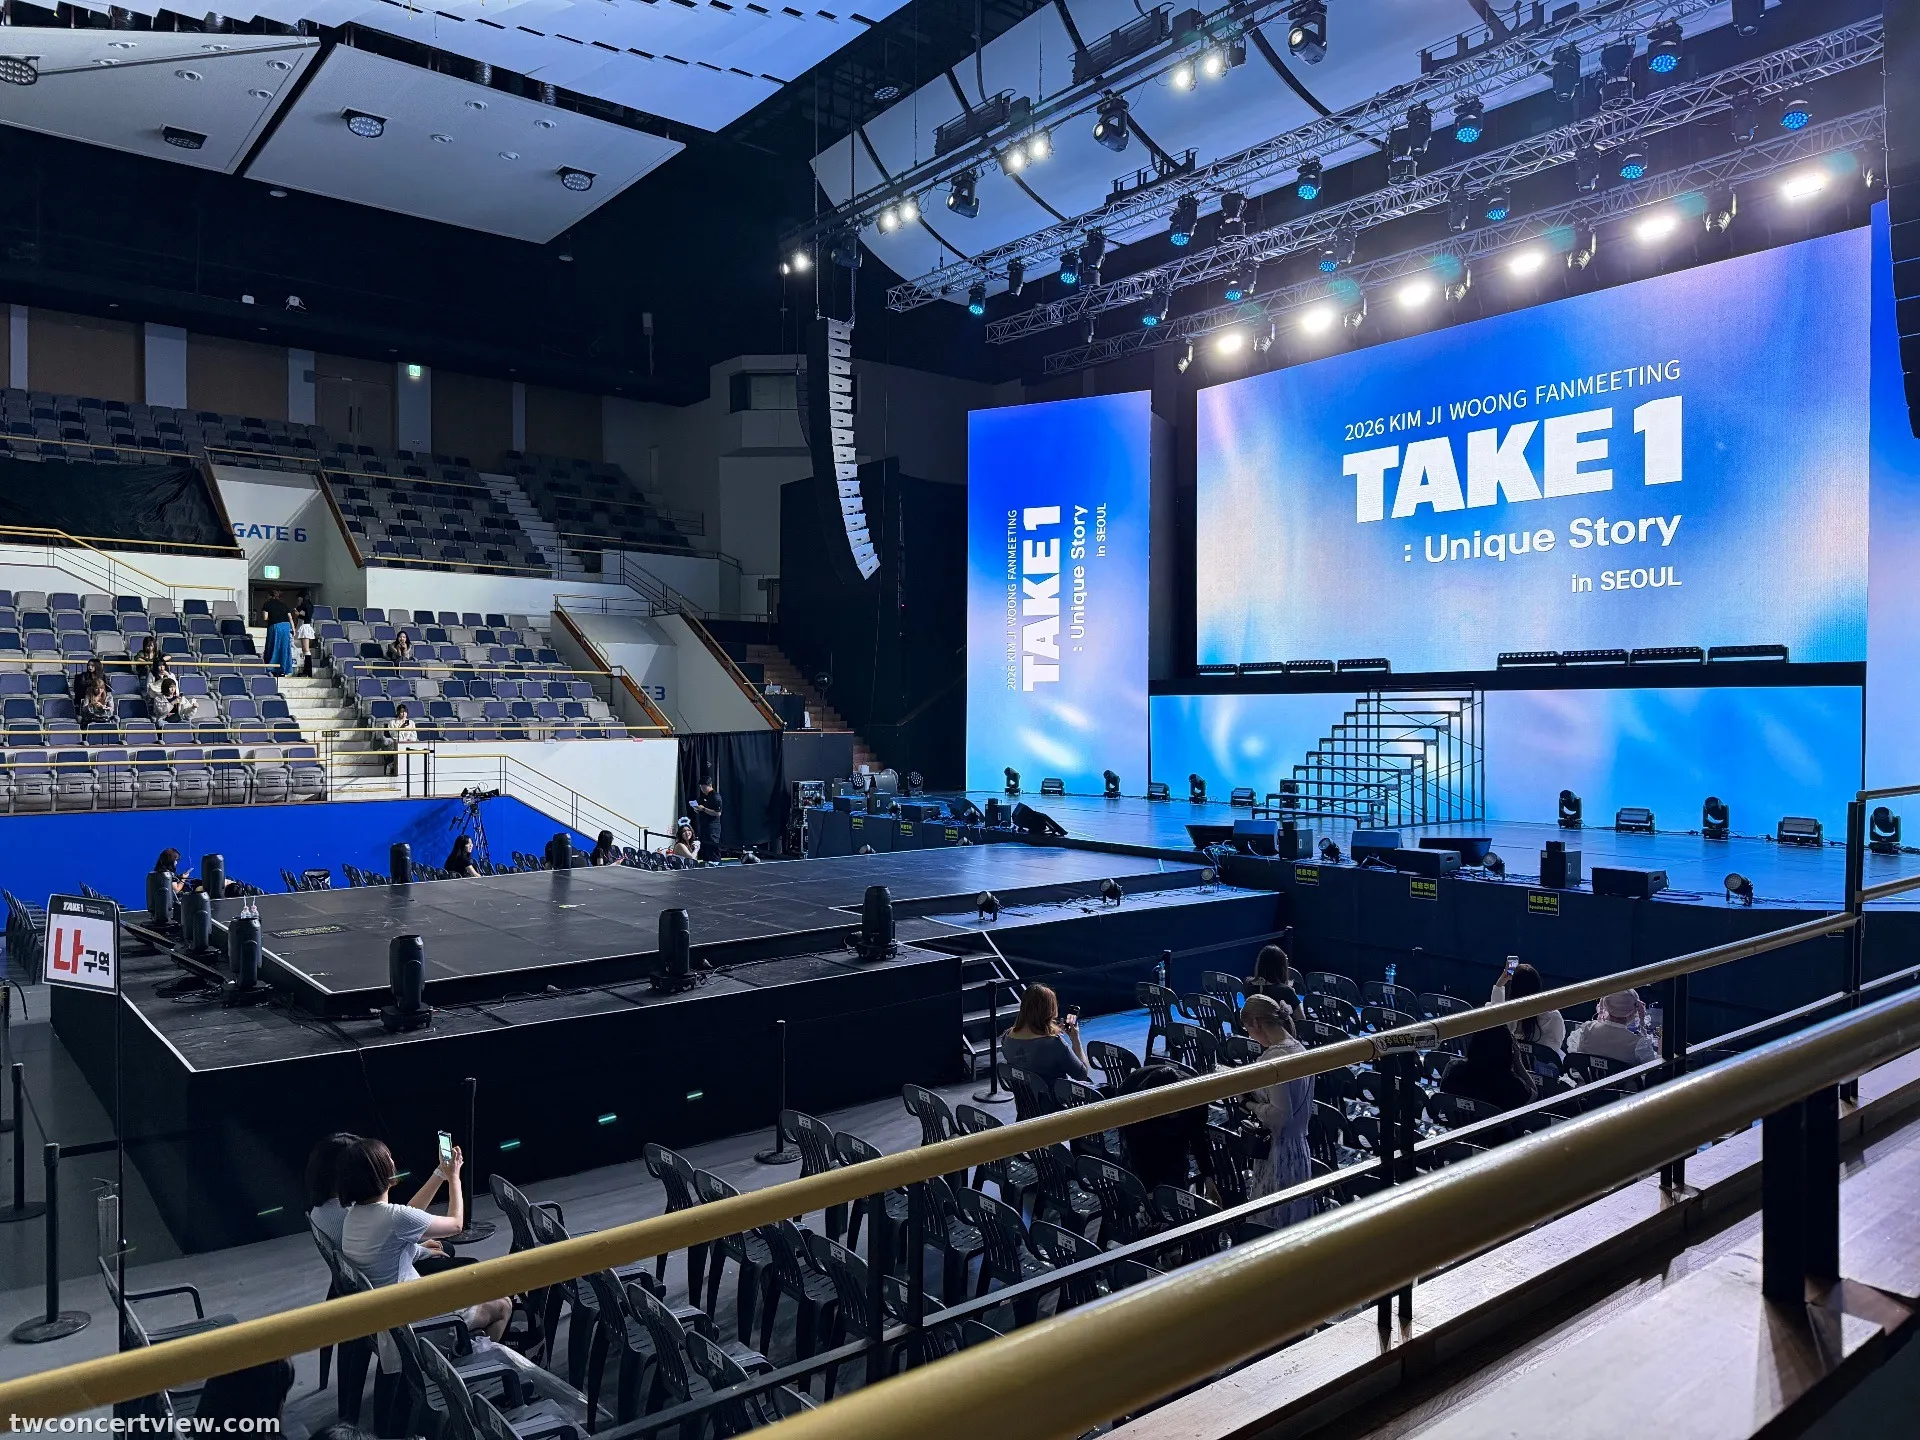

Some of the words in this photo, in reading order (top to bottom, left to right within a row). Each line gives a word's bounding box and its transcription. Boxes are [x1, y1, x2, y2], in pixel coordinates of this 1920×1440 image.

[1344, 418, 1385, 442] 2026
[1389, 410, 1422, 431] KIM
[1426, 406, 1442, 426] JI
[1449, 390, 1527, 421] WOONG
[1535, 359, 1681, 405] FANMEETING
[1343, 407, 1613, 523] TAKE
[1633, 395, 1683, 486] 1
[232, 522, 289, 542] GATE
[294, 527, 307, 543] 6
[1023, 505, 1061, 531] 1
[1071, 505, 1088, 560] Story
[1096, 502, 1107, 541] SEOUL
[1007, 509, 1018, 580] FANMEETING
[1096, 543, 1106, 557] in
[1425, 527, 1556, 563] Unique
[1569, 514, 1682, 549] Story
[1571, 573, 1592, 593] in
[1600, 566, 1682, 591] SEOUL
[1007, 583, 1017, 627] WOONG
[1022, 538, 1060, 692] TAKE
[1070, 565, 1088, 640] Unique
[1007, 630, 1017, 640] JI
[1007, 641, 1017, 662] KIM
[654, 686, 666, 701] 3
[1007, 665, 1017, 691] 2026
